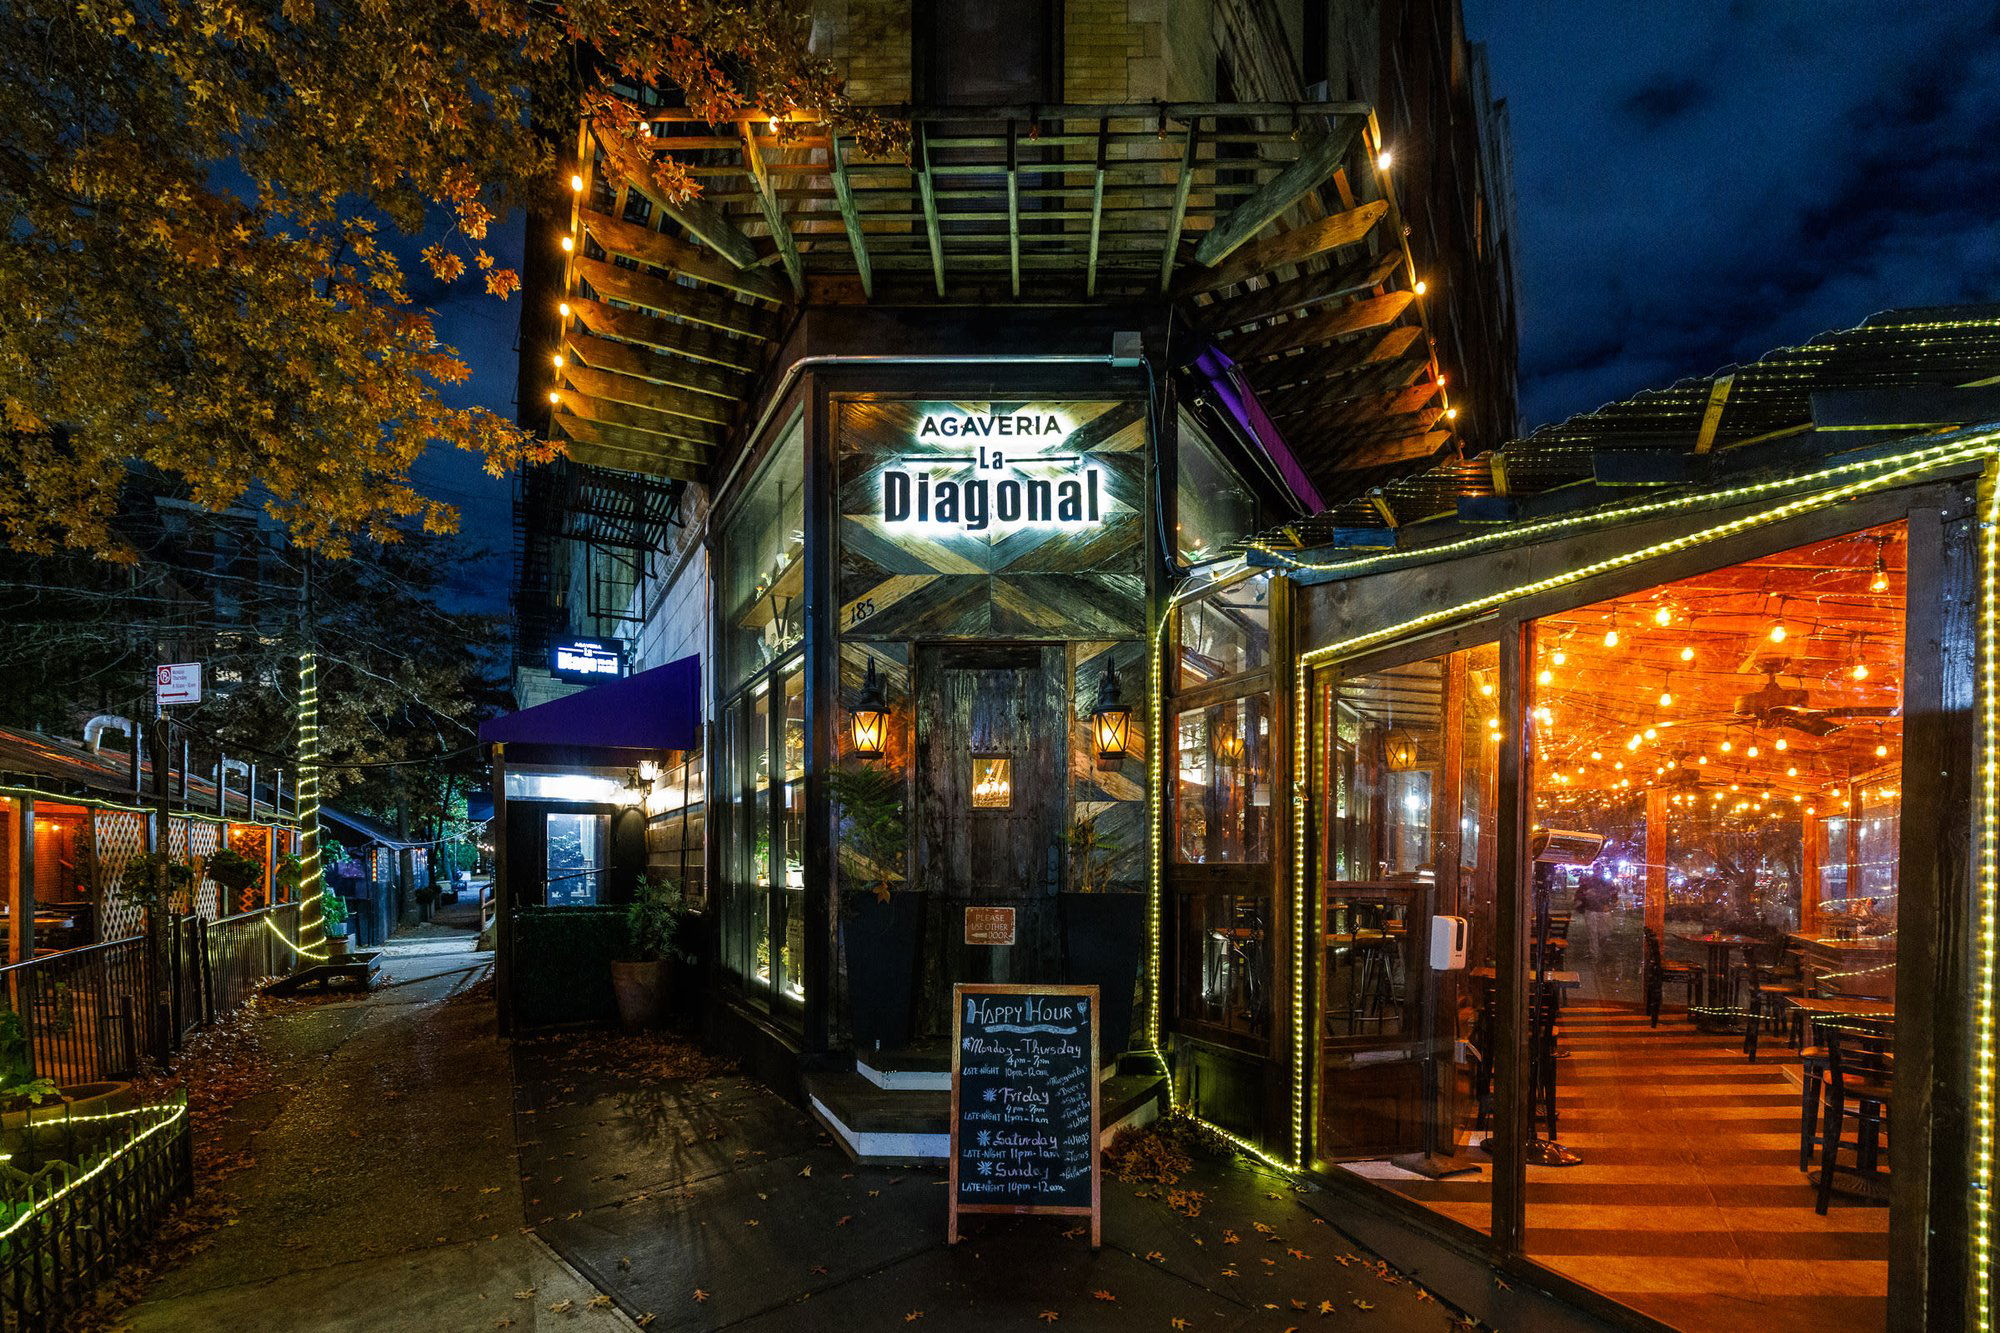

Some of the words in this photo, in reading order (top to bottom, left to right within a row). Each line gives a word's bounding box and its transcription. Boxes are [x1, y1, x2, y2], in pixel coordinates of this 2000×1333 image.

[920, 415, 1063, 437] AGAVERIA
[979, 446, 1003, 470] La
[883, 469, 1100, 531] Diagonal
[848, 597, 875, 625] 185
[970, 922, 984, 931] USE
[984, 922, 1009, 931] OTHER
[975, 913, 1005, 922] PLEASE
[988, 931, 1009, 940] DOOR
[966, 998, 1022, 1024] HAPPY
[1025, 996, 1073, 1022] HOUR
[998, 1085, 1050, 1105] Friday
[992, 1130, 1058, 1150] Saturday
[995, 1162, 1049, 1180] Sunday
